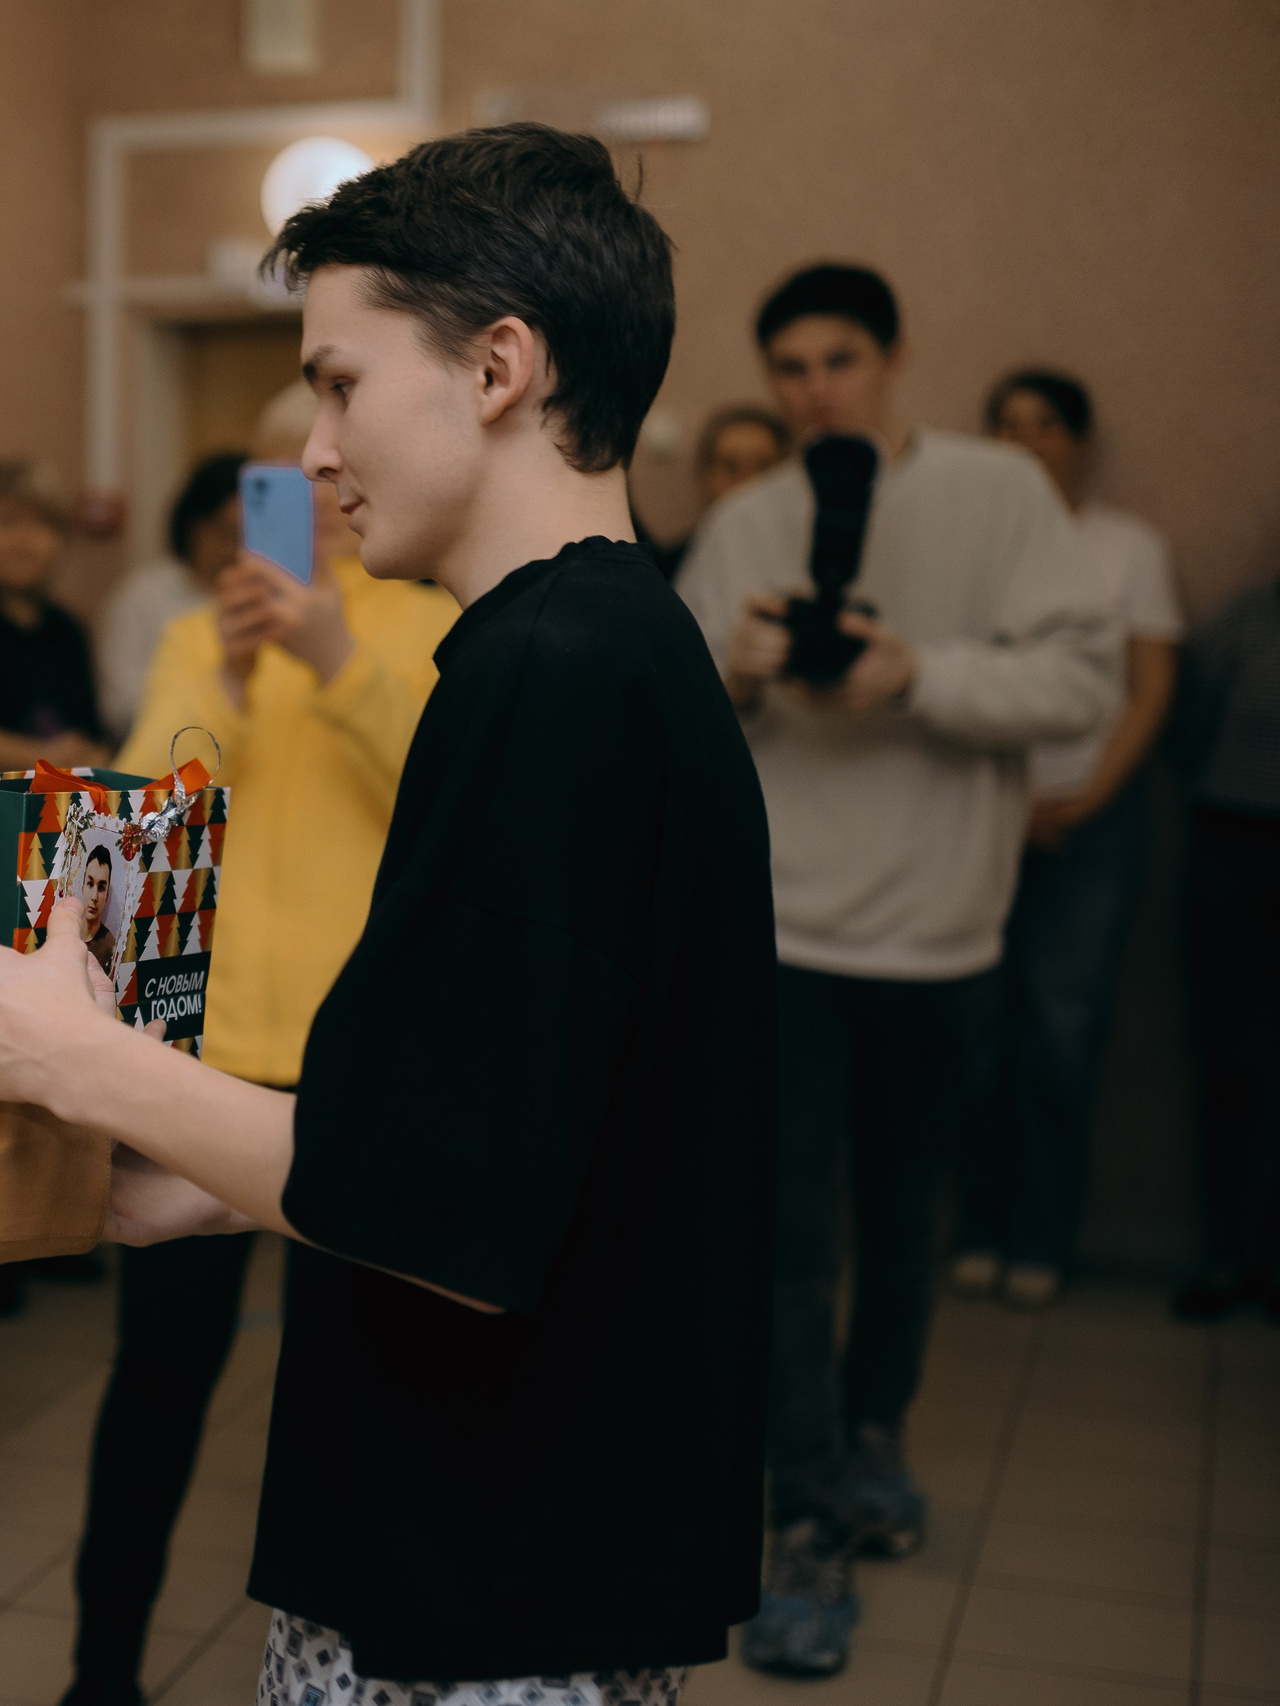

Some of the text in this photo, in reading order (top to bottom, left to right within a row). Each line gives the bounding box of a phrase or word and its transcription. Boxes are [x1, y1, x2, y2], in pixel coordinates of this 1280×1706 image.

[145, 971, 204, 998] С НОВЫМ
[151, 995, 202, 1022] ГОДОМ!
